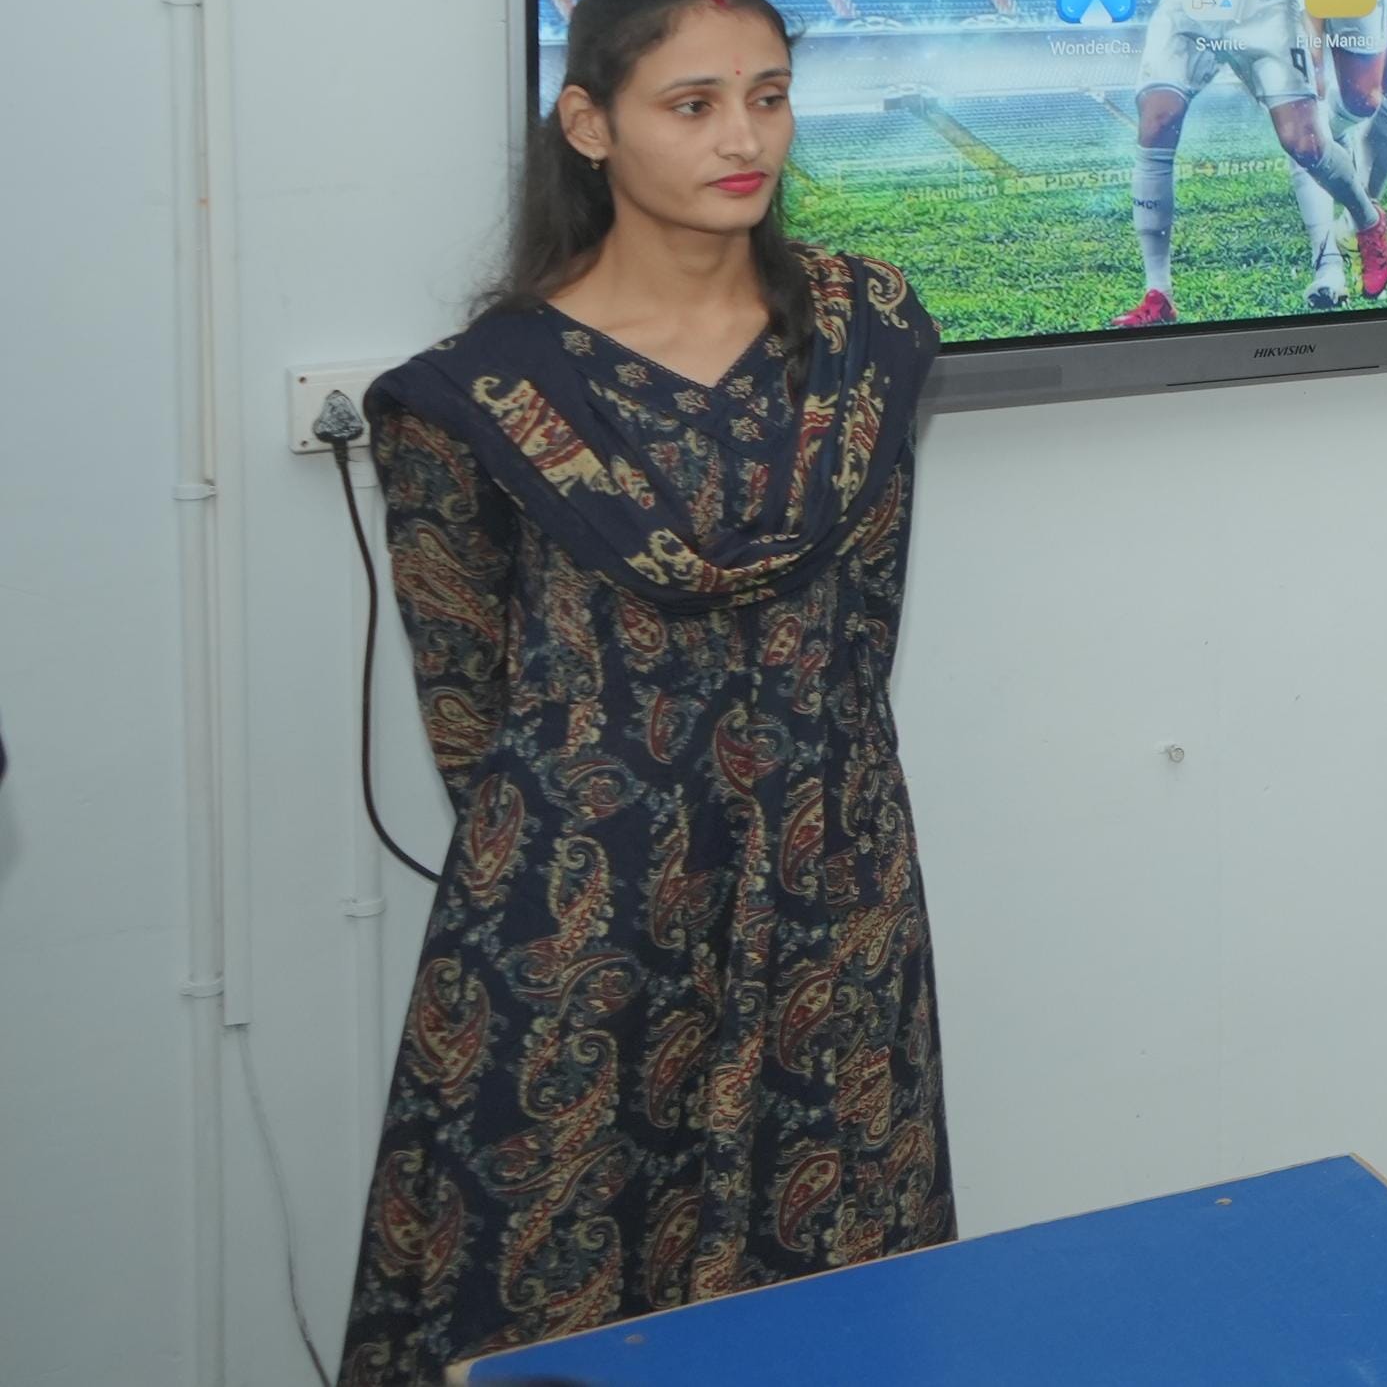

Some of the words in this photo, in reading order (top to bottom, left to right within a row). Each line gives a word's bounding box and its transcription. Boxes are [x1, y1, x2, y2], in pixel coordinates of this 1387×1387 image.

[1196, 36, 1248, 52] S-write
[1218, 158, 1286, 174] MasterC
[1253, 344, 1317, 359] HIKVISION
